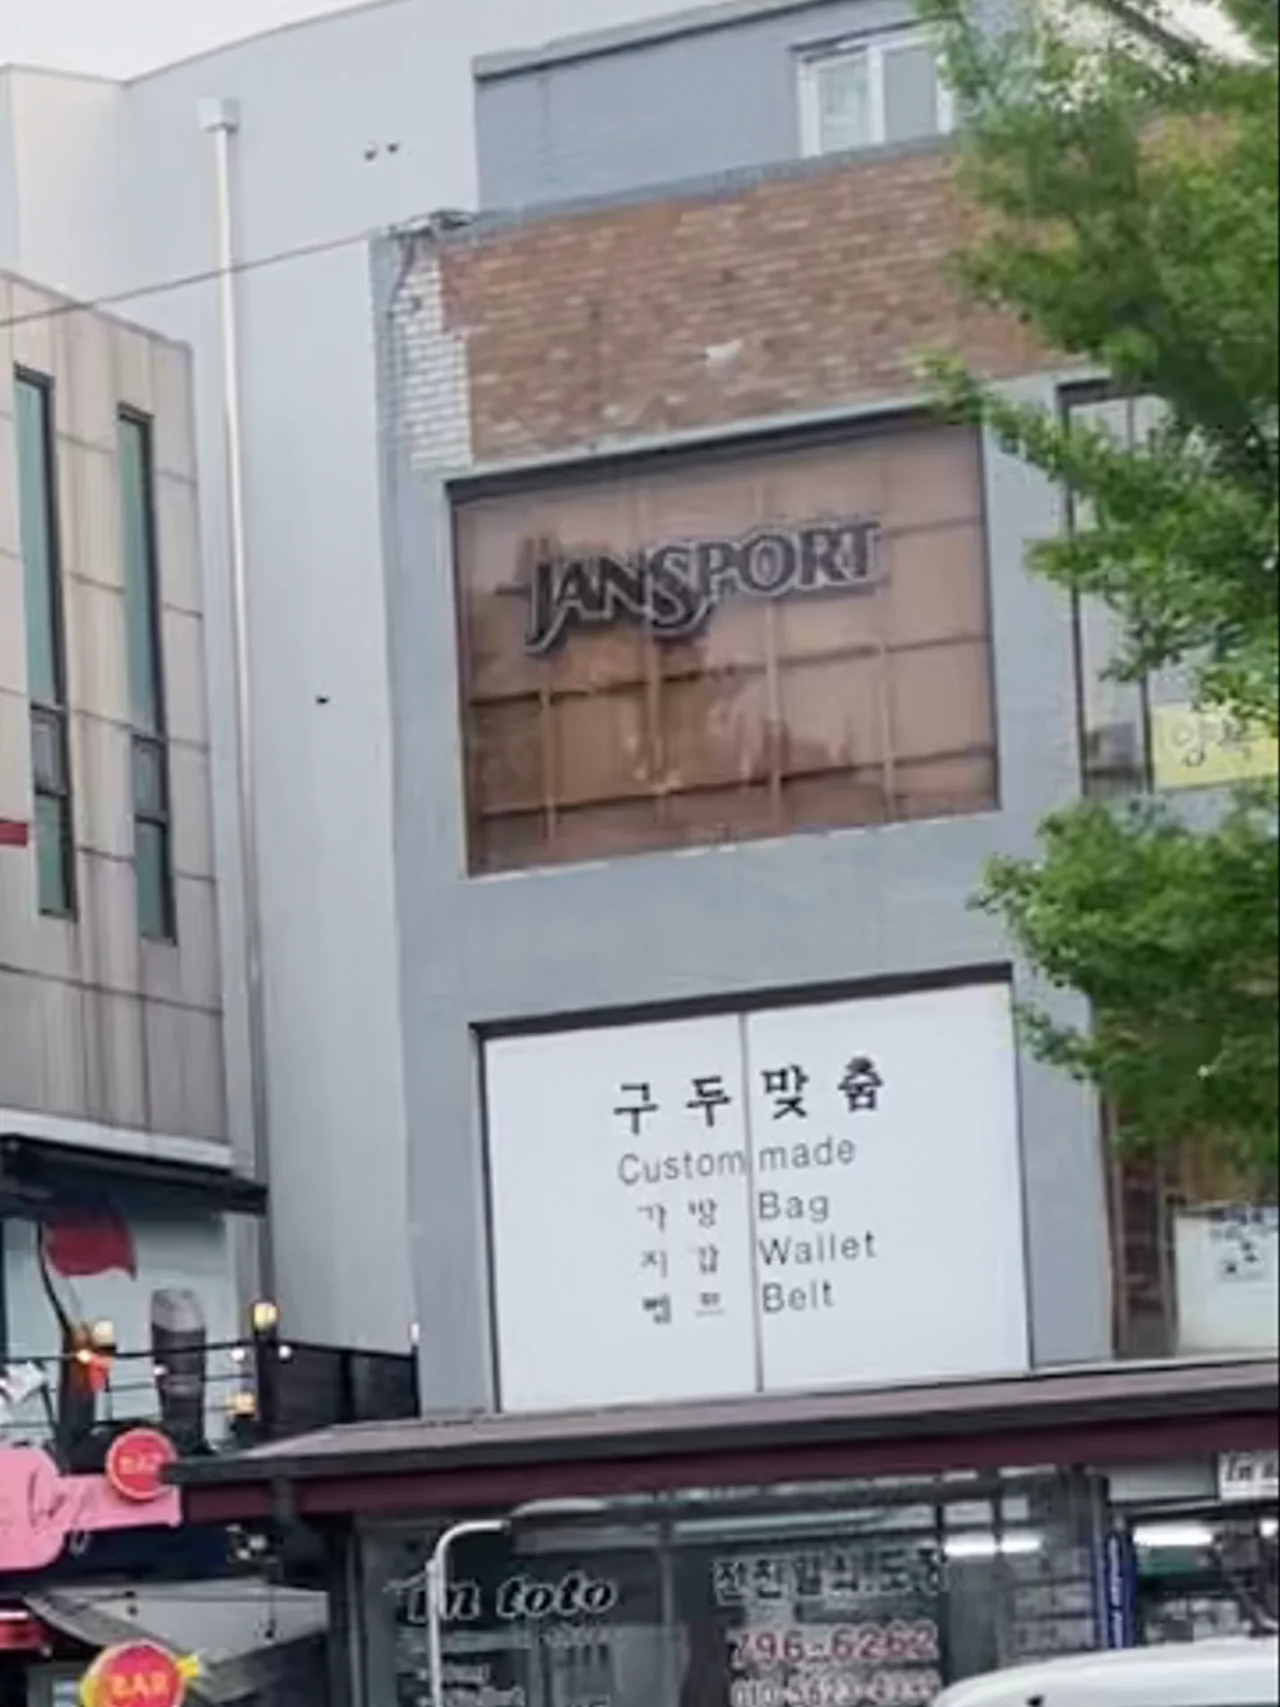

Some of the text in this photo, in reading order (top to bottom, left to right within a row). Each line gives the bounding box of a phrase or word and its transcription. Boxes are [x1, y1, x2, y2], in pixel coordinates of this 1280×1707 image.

[527, 519, 881, 655] JANSPORT
[617, 1136, 856, 1186] Custom made
[759, 1191, 830, 1224] Bag
[759, 1229, 877, 1266] Wallet
[762, 1279, 835, 1314] Belt
